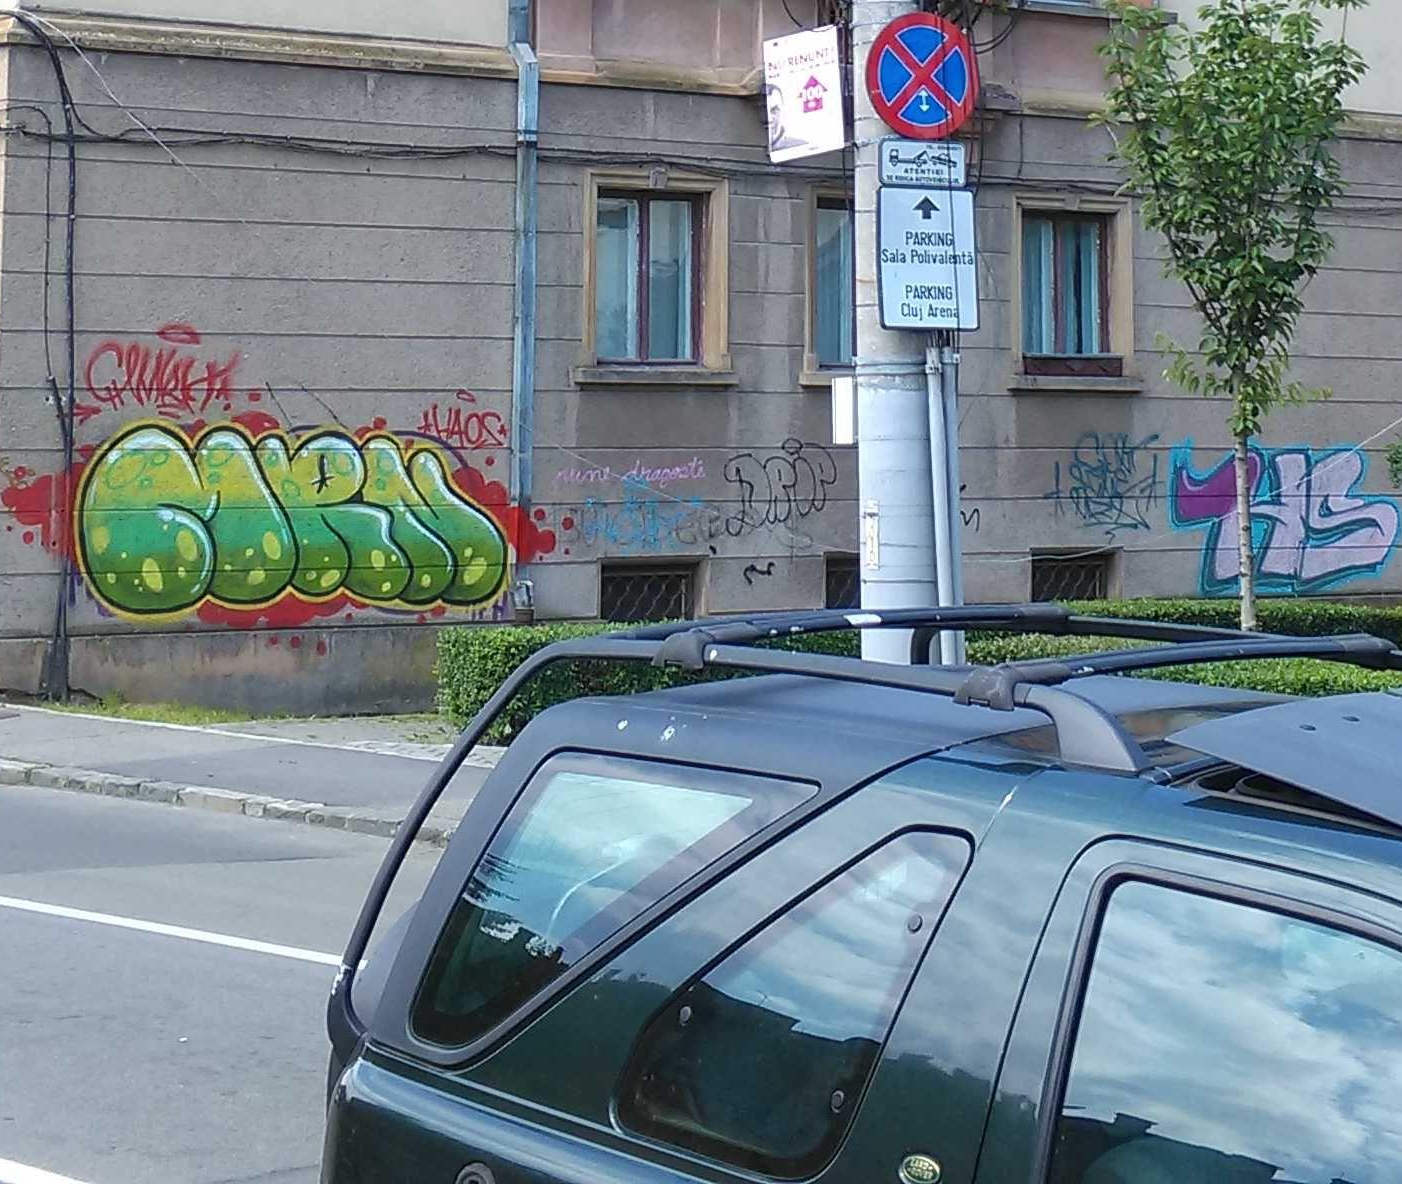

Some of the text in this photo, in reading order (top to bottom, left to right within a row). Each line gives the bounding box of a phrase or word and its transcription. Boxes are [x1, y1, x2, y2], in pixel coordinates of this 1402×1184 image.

[905, 231, 953, 247] PARKING
[881, 248, 974, 265] Sala Polivalentă
[905, 284, 953, 300] PARKING
[900, 302, 959, 321] Cluj Arena
